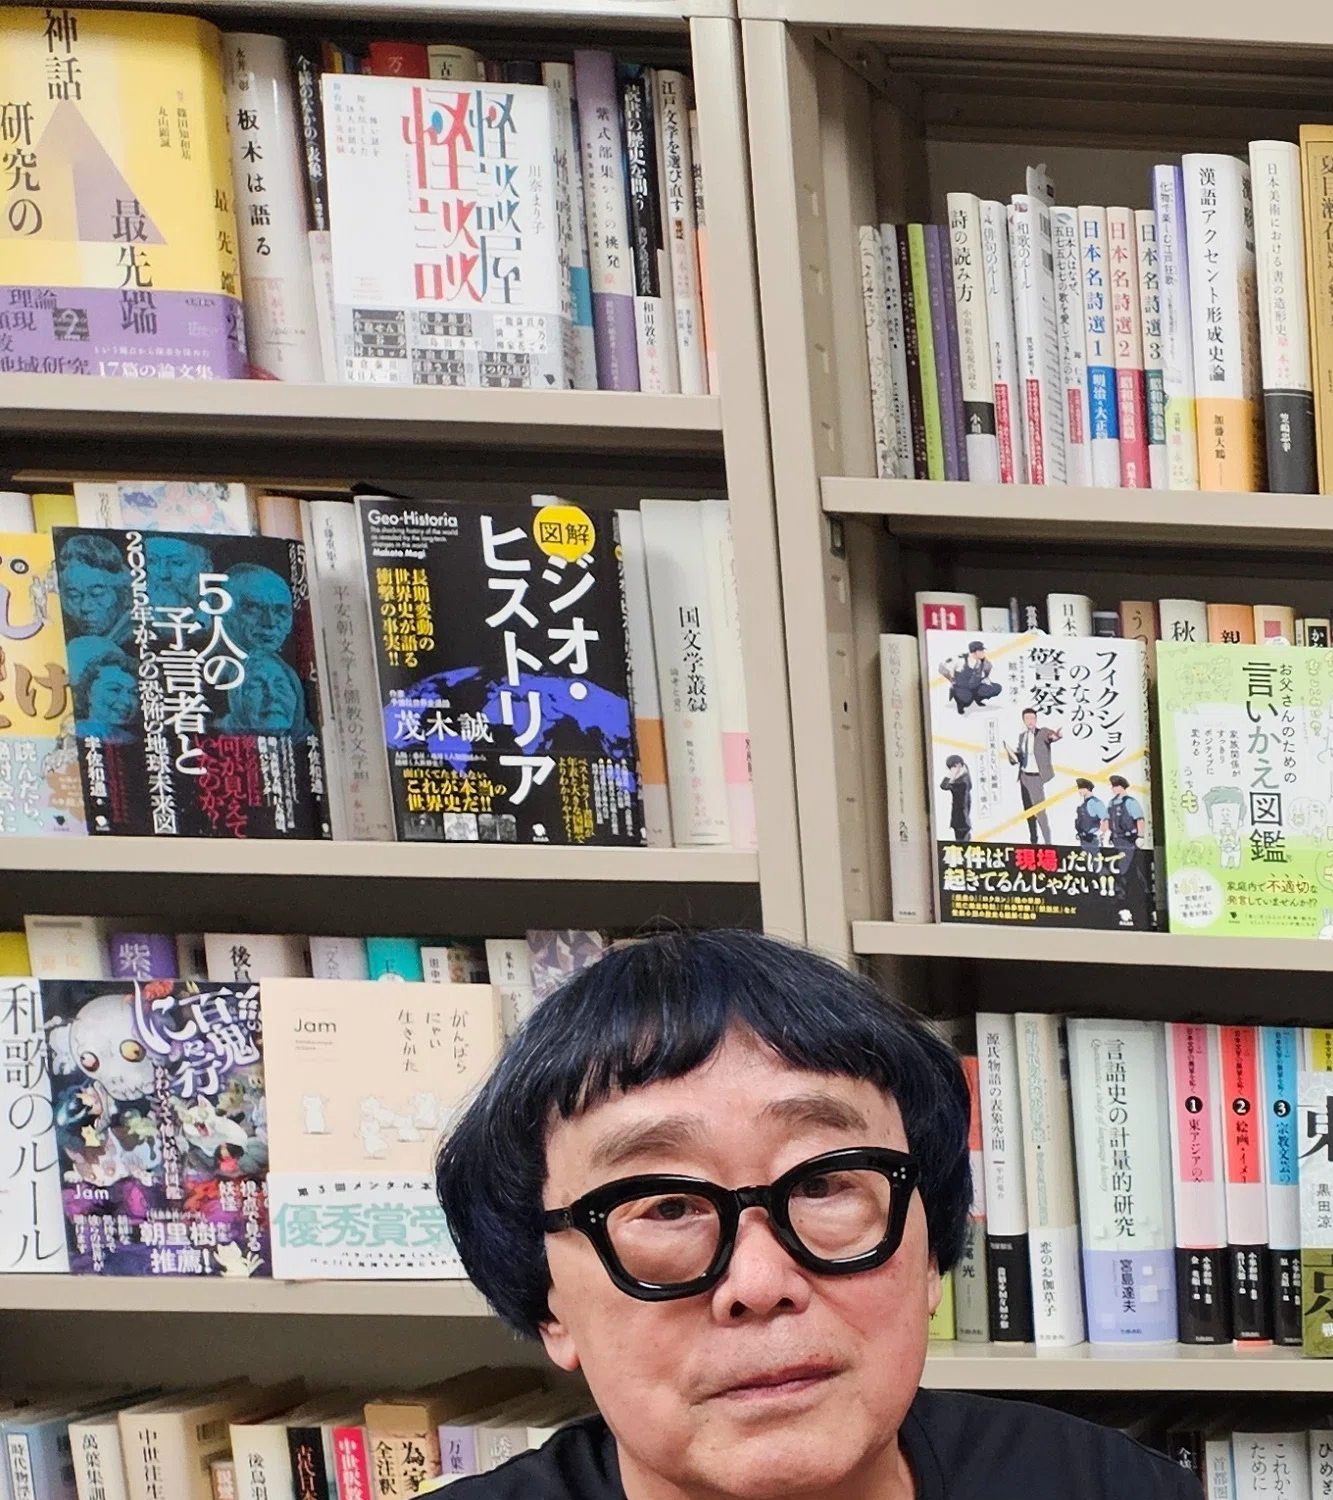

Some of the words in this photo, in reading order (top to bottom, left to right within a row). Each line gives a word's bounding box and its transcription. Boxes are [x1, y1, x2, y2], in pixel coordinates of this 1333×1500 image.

[44, 8, 83, 102] 神話
[0, 100, 44, 237] 研究の
[661, 80, 685, 213] 江戸文学を選び直す
[237, 108, 272, 257] 板木は語る
[528, 163, 545, 235] 川奈まり子
[111, 198, 158, 336] 最先端
[950, 210, 974, 303] 詩の読み方
[982, 225, 1000, 296] 俳句のルール
[1015, 221, 1032, 291] 和歌のルール
[1198, 165, 1227, 385] 漢語アクセント形成史論
[1266, 162, 1290, 337] 日本美術における書の造形史
[539, 521, 591, 546] 図解
[197, 572, 249, 692] 5人の
[394, 568, 419, 669] 世界史が語る
[412, 568, 436, 652] 長期変動の
[541, 551, 600, 701] ジオ・
[1170, 620, 1197, 643] 秋
[152, 606, 213, 777] 予言者と
[480, 514, 557, 805] ヒストリア
[1027, 646, 1068, 716] 警察
[393, 710, 495, 744] 茂木誠
[1068, 665, 1094, 741] のなかの
[1096, 650, 1128, 765] フィクション
[1278, 663, 1299, 784] お父さんのための
[1190, 728, 1200, 757] 変わる
[1203, 728, 1216, 776] ポジティブに
[1216, 730, 1227, 764] すっきり
[1229, 729, 1241, 779] 家族関係が
[1242, 661, 1289, 864] 言いかえ図鑑
[406, 778, 507, 798] これが本当の
[941, 845, 1127, 875] 事件は「現場」だけで
[1225, 879, 1318, 895] 家庭内で不適切な
[293, 1018, 338, 1035] Jam
[398, 1008, 420, 1074] 生きかた
[425, 1011, 443, 1050] にゃい
[450, 1008, 470, 1074] がんばら
[0, 981, 65, 1269] 和歌のルール
[985, 1031, 1006, 1153] 源氏物語の表象空間
[1103, 1038, 1136, 1239] 言語史の計量的研究
[72, 1186, 110, 1202] Jam
[1316, 1182, 1333, 1229] 黒田涼
[139, 1222, 218, 1247] 朝里樹
[1119, 1258, 1137, 1313] 宮島達夫
[376, 1441, 398, 1497] 全注釈
[399, 1440, 427, 1495] 為家
[1249, 1442, 1268, 1493] ために
